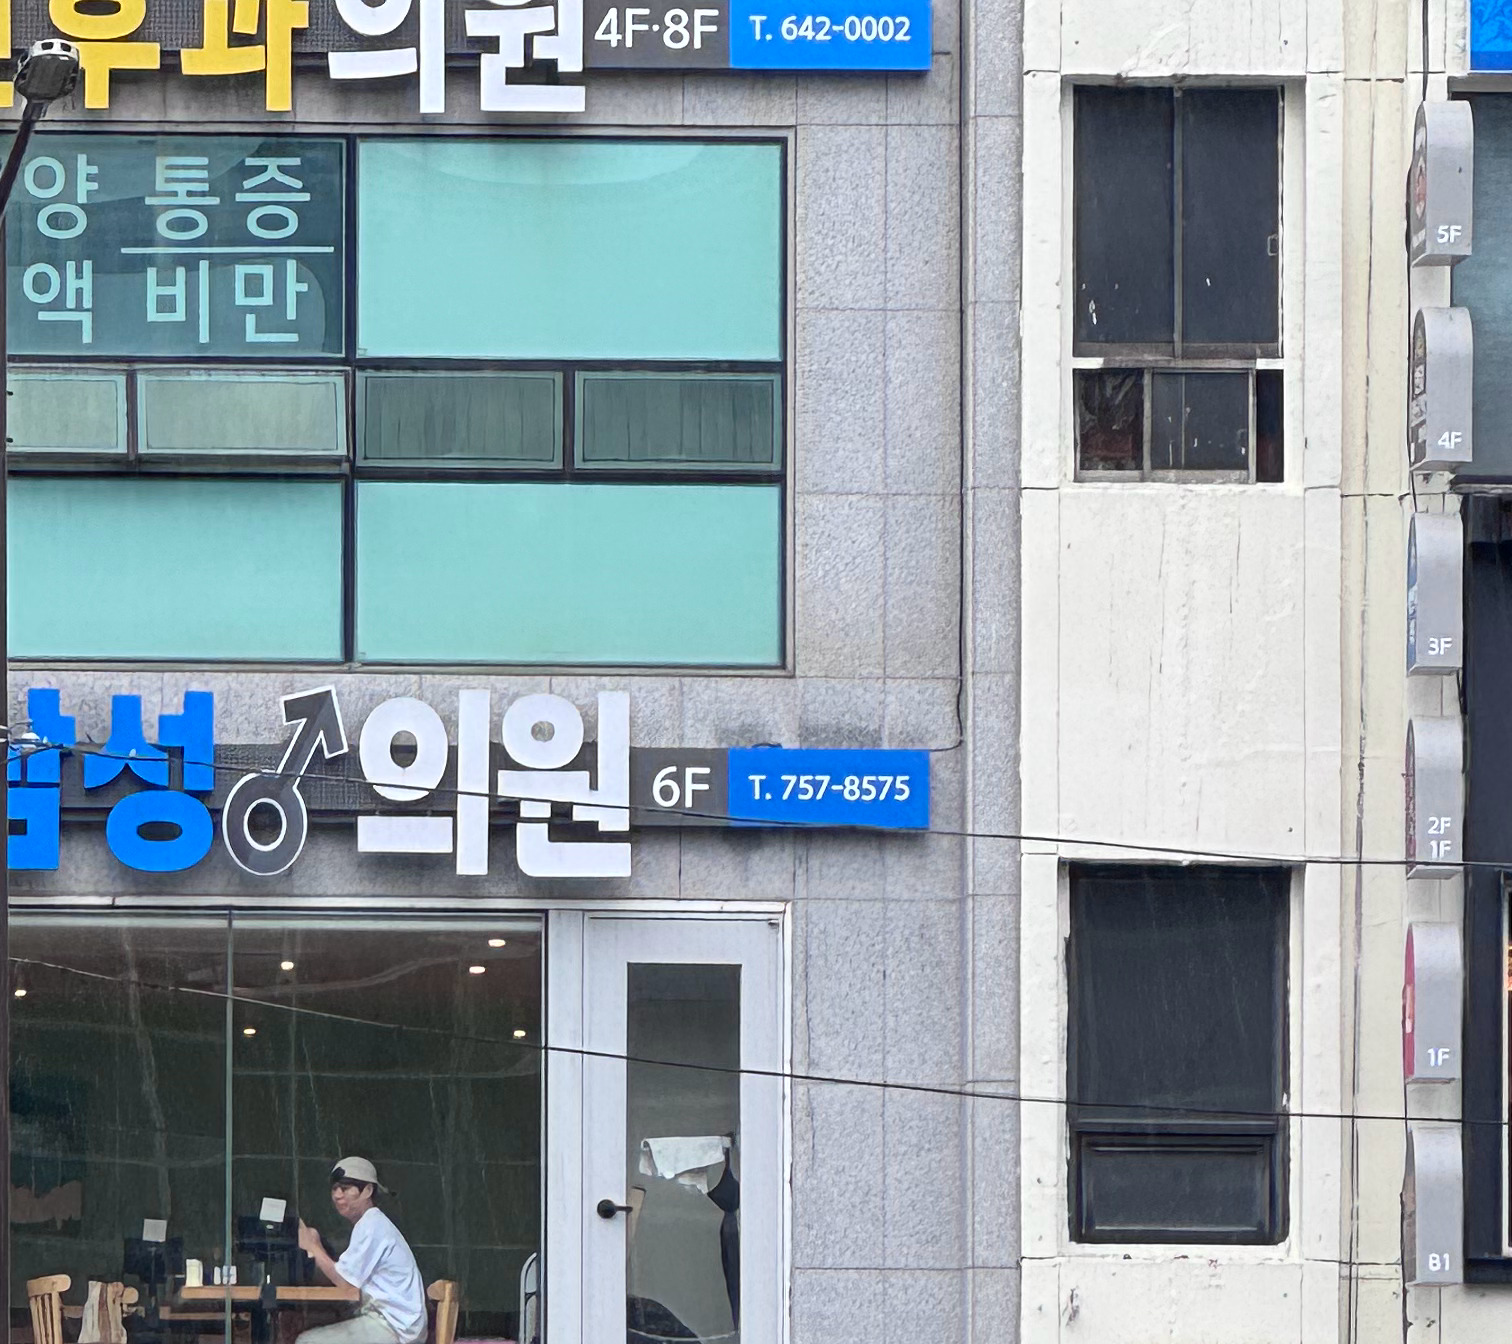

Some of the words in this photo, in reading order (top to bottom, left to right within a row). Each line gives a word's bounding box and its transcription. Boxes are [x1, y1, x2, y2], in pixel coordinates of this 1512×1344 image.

[750, 15, 772, 41] T.
[781, 14, 912, 42] 642-0002
[1437, 225, 1463, 243] 5F
[146, 259, 309, 344] 비만
[1437, 431, 1463, 449] 4F
[1428, 637, 1453, 655] 3F
[357, 689, 633, 878] 의원
[652, 765, 711, 808] 6F
[748, 774, 772, 801] T.
[780, 775, 911, 801] 757-8575
[1427, 816, 1452, 835] 2F
[1429, 840, 1452, 859] 1F
[1427, 1047, 1450, 1067] 1F
[1428, 1253, 1450, 1272] B1
